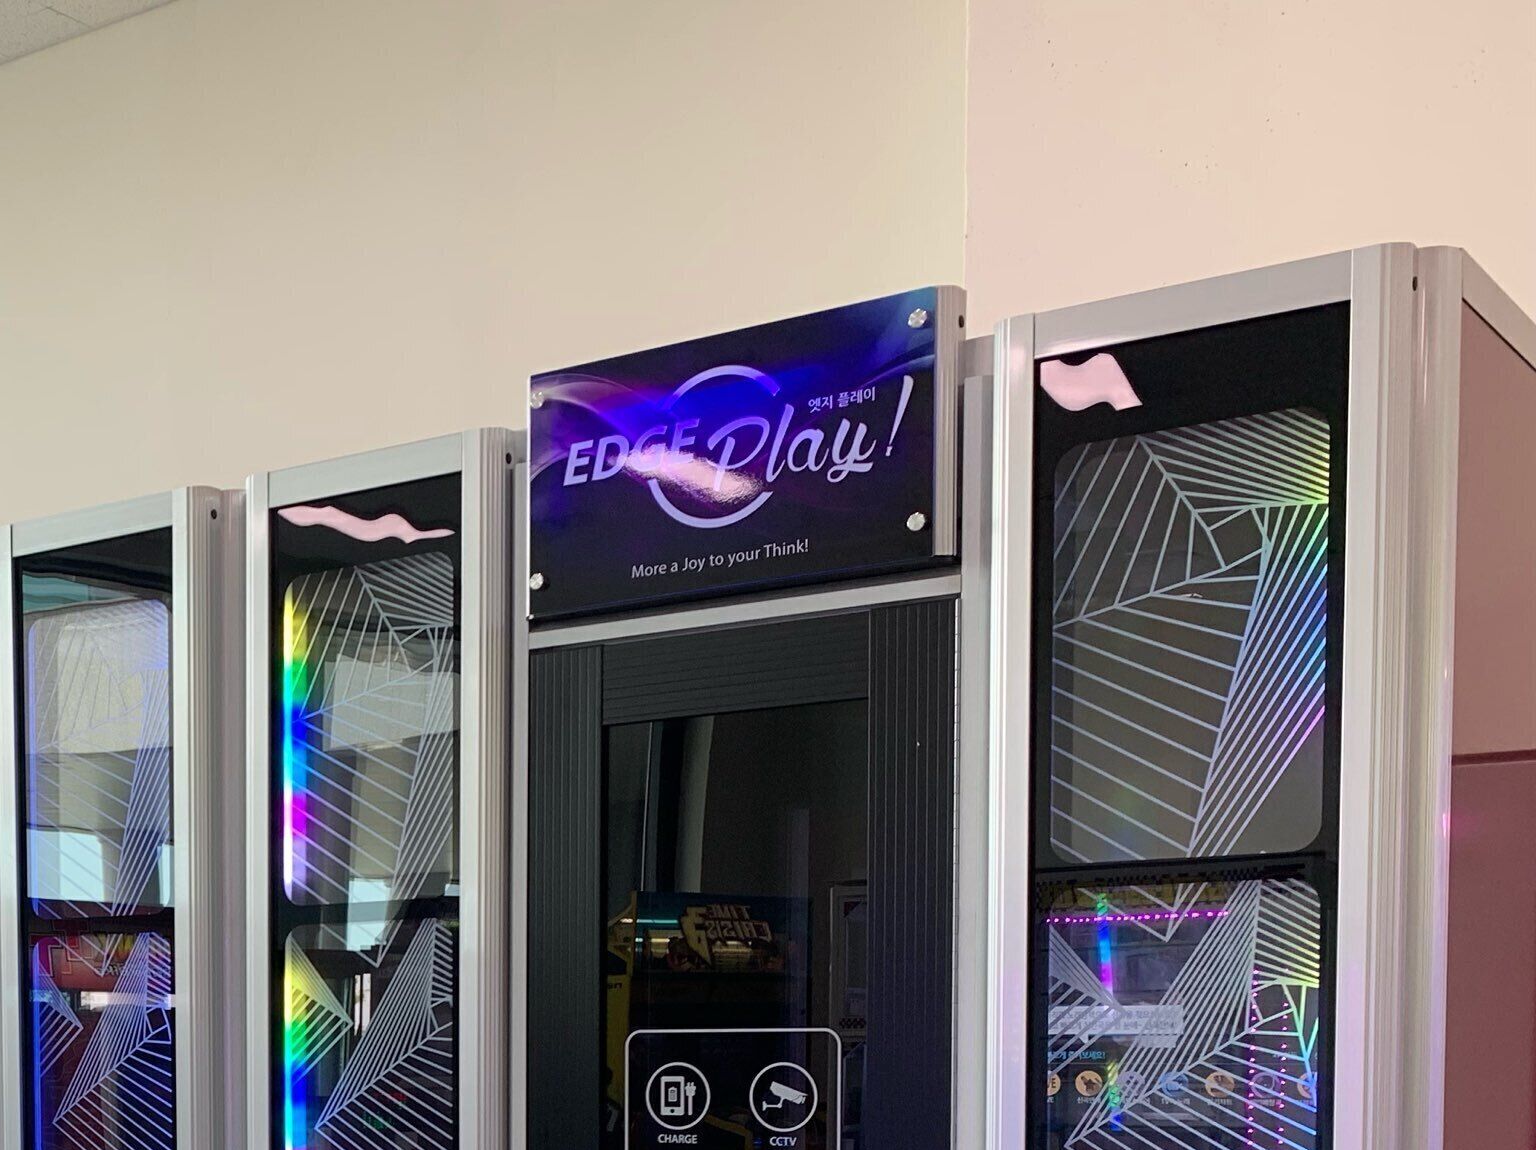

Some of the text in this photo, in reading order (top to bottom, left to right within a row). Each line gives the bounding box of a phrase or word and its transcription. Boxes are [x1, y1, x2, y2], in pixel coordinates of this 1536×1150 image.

[807, 386, 876, 413] 엣지 플레이
[563, 374, 914, 493] EDGE Play!
[631, 538, 809, 578] More a Joy to your Think!
[657, 1133, 698, 1144] CHARGE
[769, 1136, 797, 1147] CCTV
